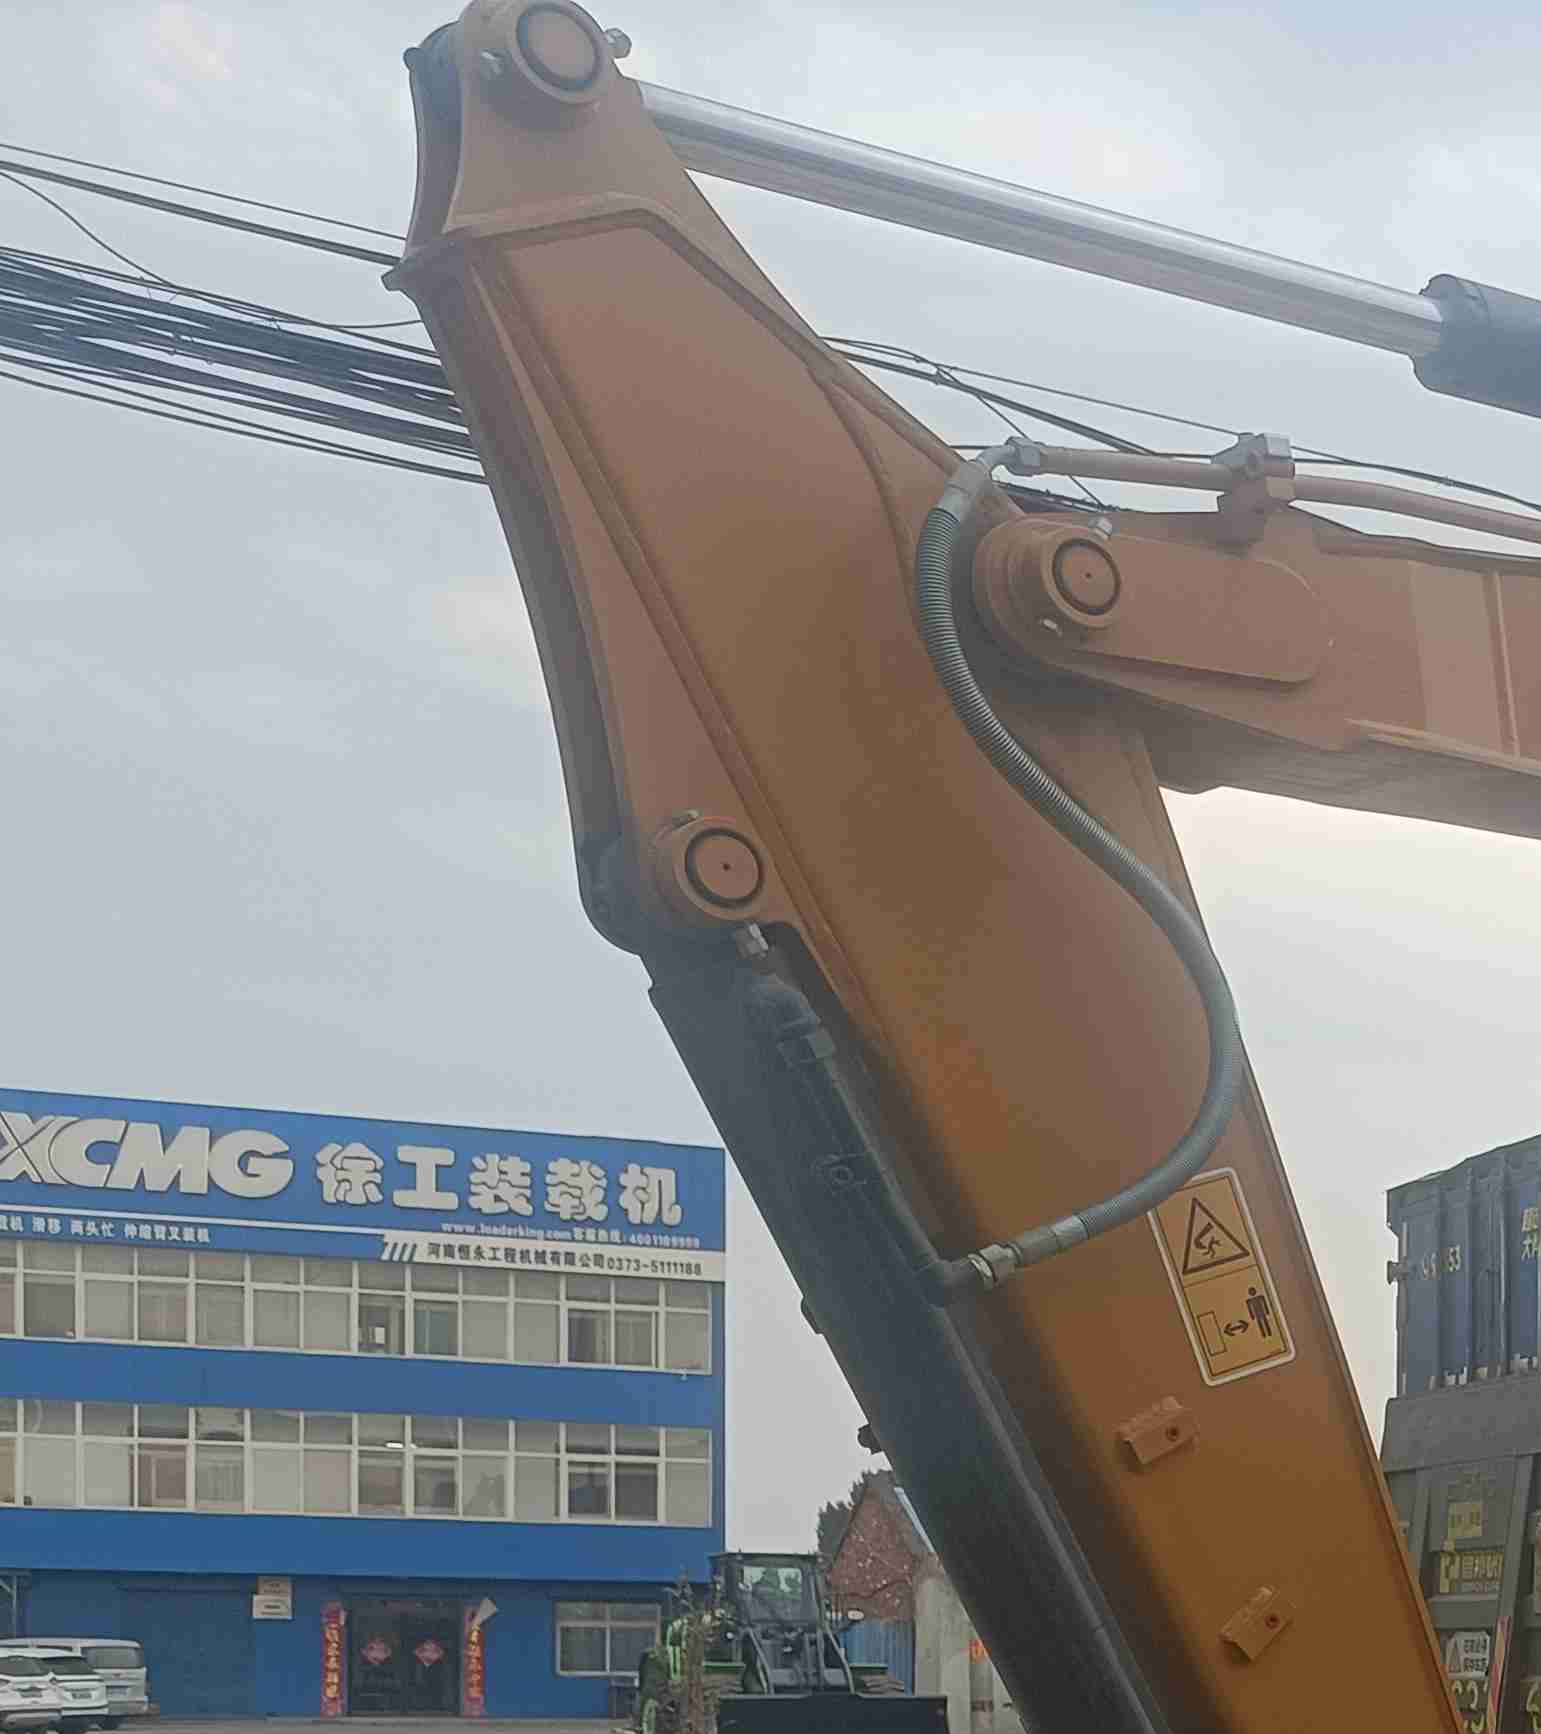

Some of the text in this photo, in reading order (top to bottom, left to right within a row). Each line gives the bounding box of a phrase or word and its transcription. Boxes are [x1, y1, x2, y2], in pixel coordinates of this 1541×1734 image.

[0, 1111, 294, 1199] XCMG
[316, 1143, 682, 1225] 徐工装载机
